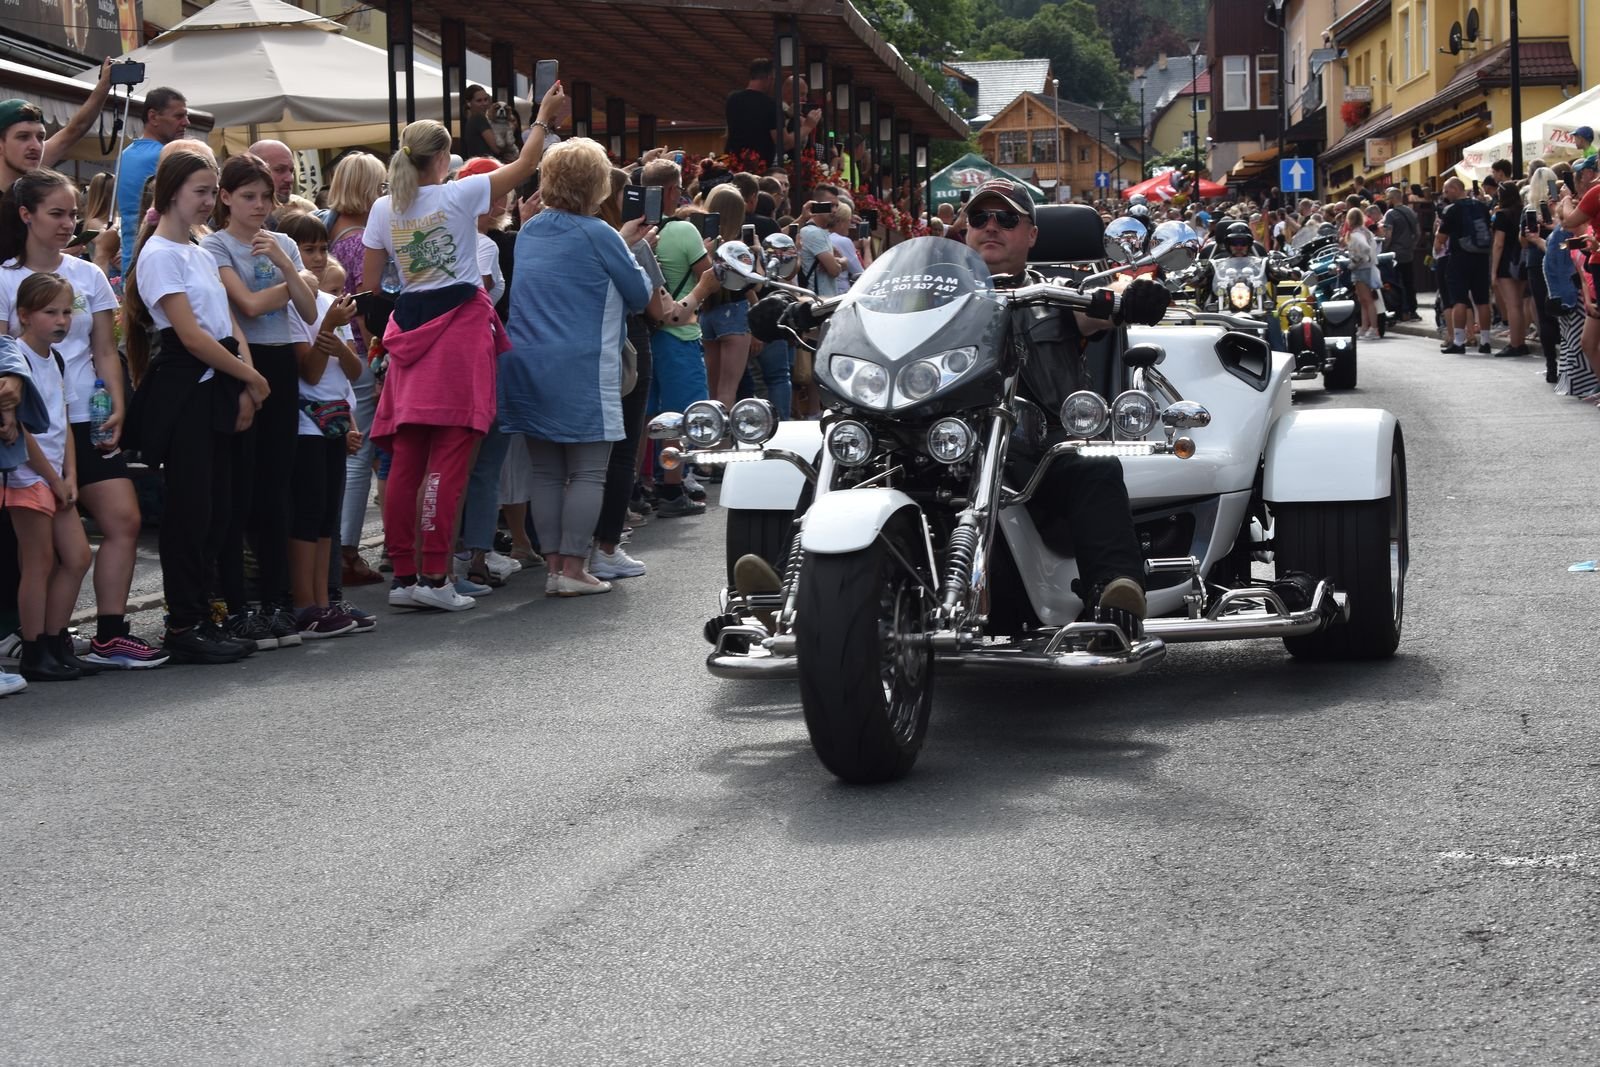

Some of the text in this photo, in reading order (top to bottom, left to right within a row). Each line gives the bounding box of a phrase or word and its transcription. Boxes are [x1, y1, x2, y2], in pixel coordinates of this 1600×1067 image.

[391, 211, 448, 230] SUMMER
[400, 239, 438, 253] DANCE
[441, 234, 456, 255] 3
[873, 274, 958, 290] SPRZEDAM
[913, 282, 934, 290] 437
[936, 284, 957, 293] 447
